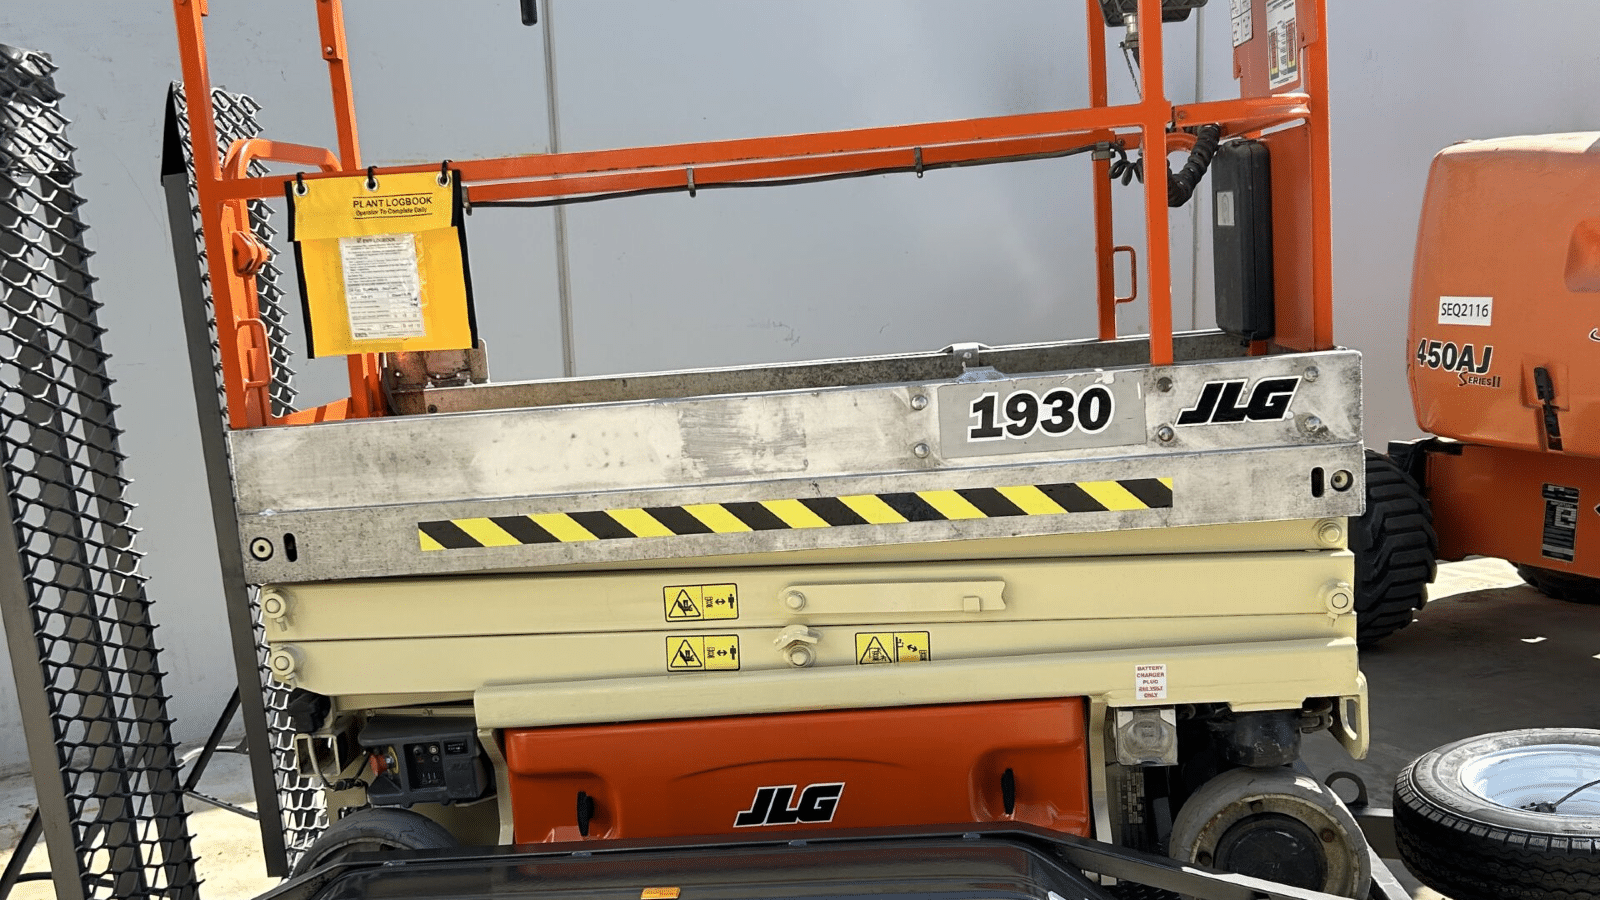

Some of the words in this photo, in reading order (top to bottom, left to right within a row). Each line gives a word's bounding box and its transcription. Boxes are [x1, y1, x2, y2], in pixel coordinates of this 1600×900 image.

[353, 199, 384, 208] PLANT
[386, 196, 432, 207] LOGBOOK
[388, 207, 413, 215] Complete
[1441, 303, 1489, 318] SEQ2116
[1417, 338, 1493, 375] 450AJ
[968, 384, 1114, 441] 1930
[1175, 375, 1302, 427] JLG
[733, 782, 845, 827] JLG
